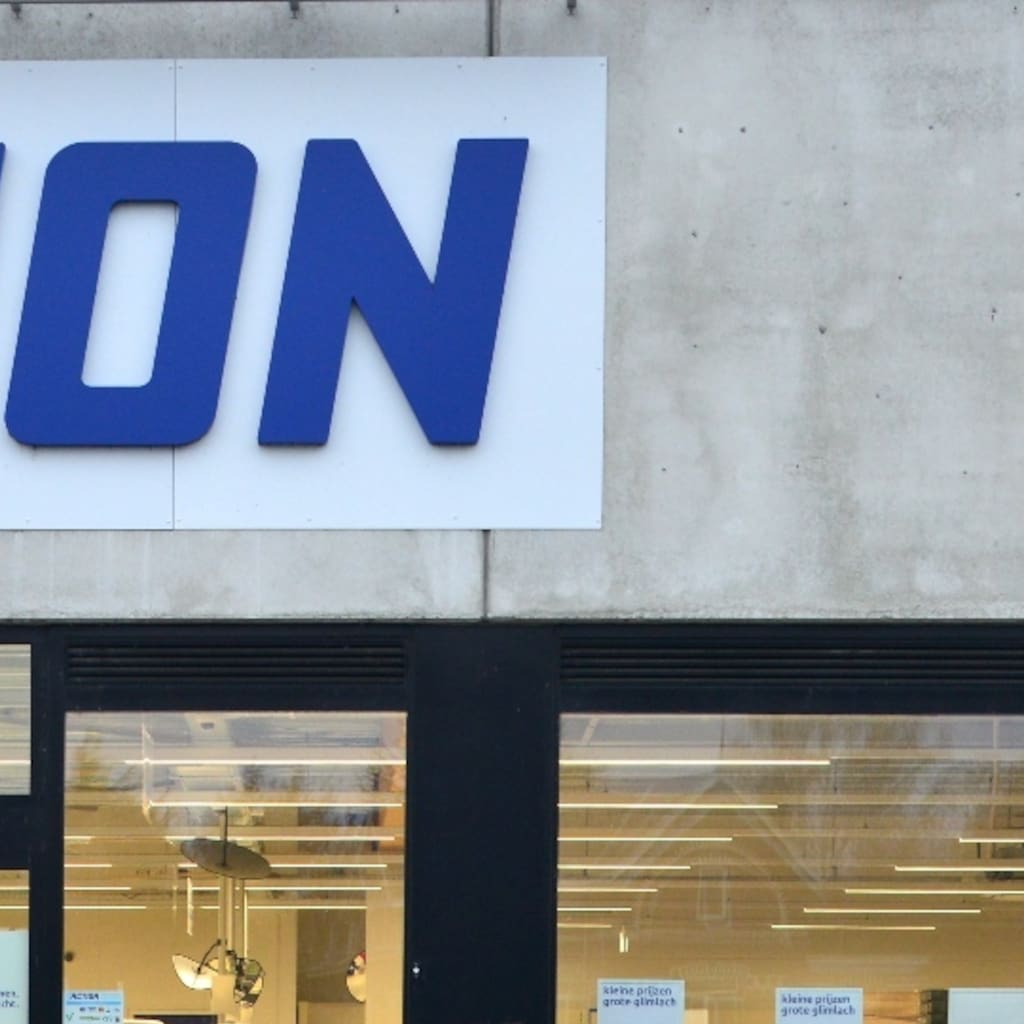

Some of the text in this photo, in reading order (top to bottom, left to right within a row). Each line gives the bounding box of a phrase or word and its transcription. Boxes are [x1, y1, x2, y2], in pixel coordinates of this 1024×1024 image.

[602, 985, 673, 997] kleine prijzen
[633, 996, 676, 1008] glimlach
[781, 993, 851, 1005] kleine prijzen
[812, 1004, 856, 1017] glimlach
